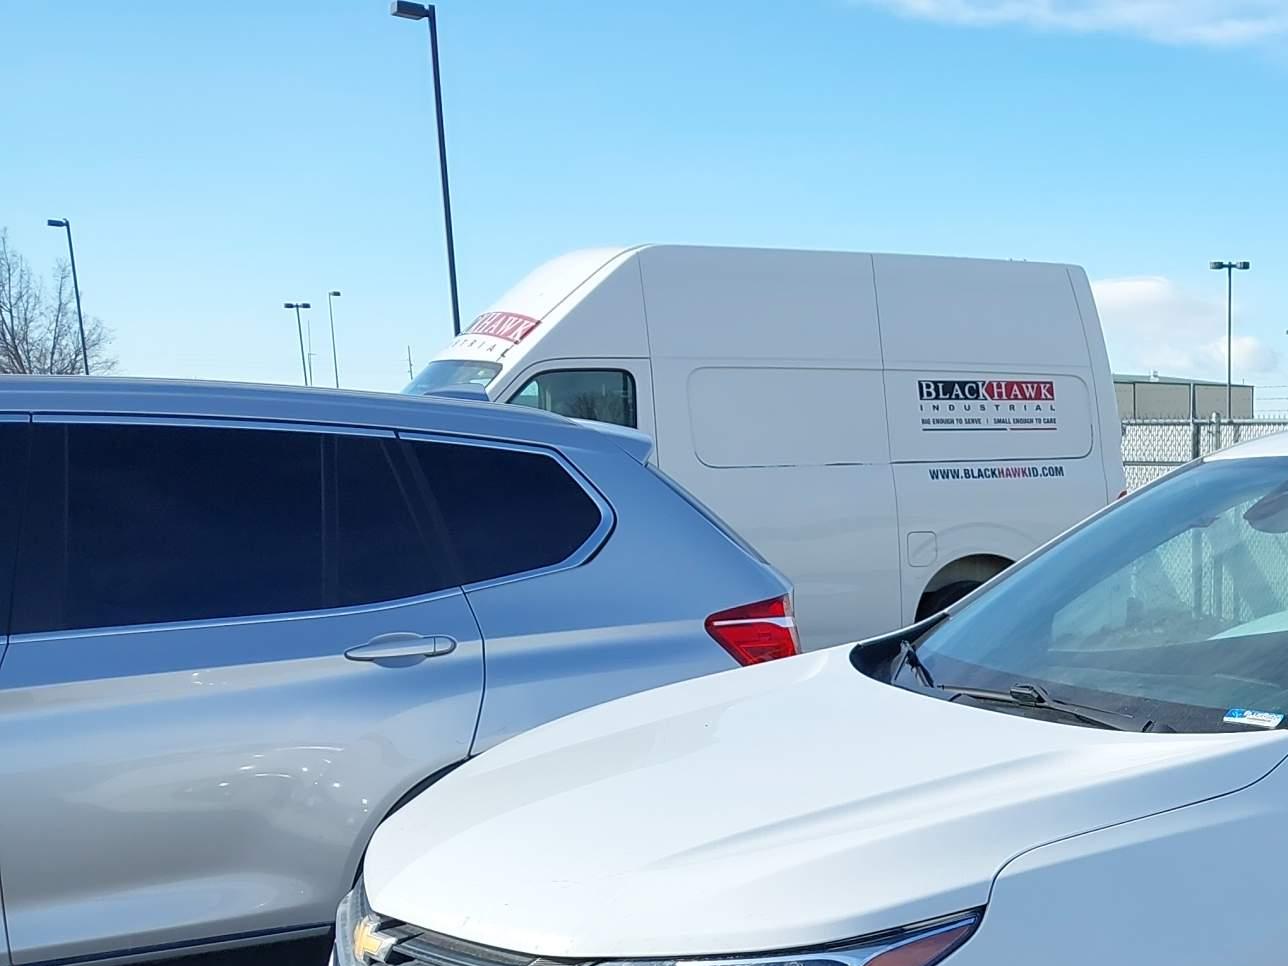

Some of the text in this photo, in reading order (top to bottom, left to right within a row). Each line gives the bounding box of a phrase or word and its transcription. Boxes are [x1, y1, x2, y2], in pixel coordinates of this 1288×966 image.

[919, 380, 1055, 401] BLACKHAWK
[920, 404, 1056, 412] INDUSTRIAL
[993, 417, 1012, 425] SMALL
[1013, 417, 1034, 425] ENOUGH
[1035, 417, 1042, 425] TO
[1043, 417, 1057, 425] CARE
[929, 466, 1065, 480] WWW.BLACKHAWKID.COM
